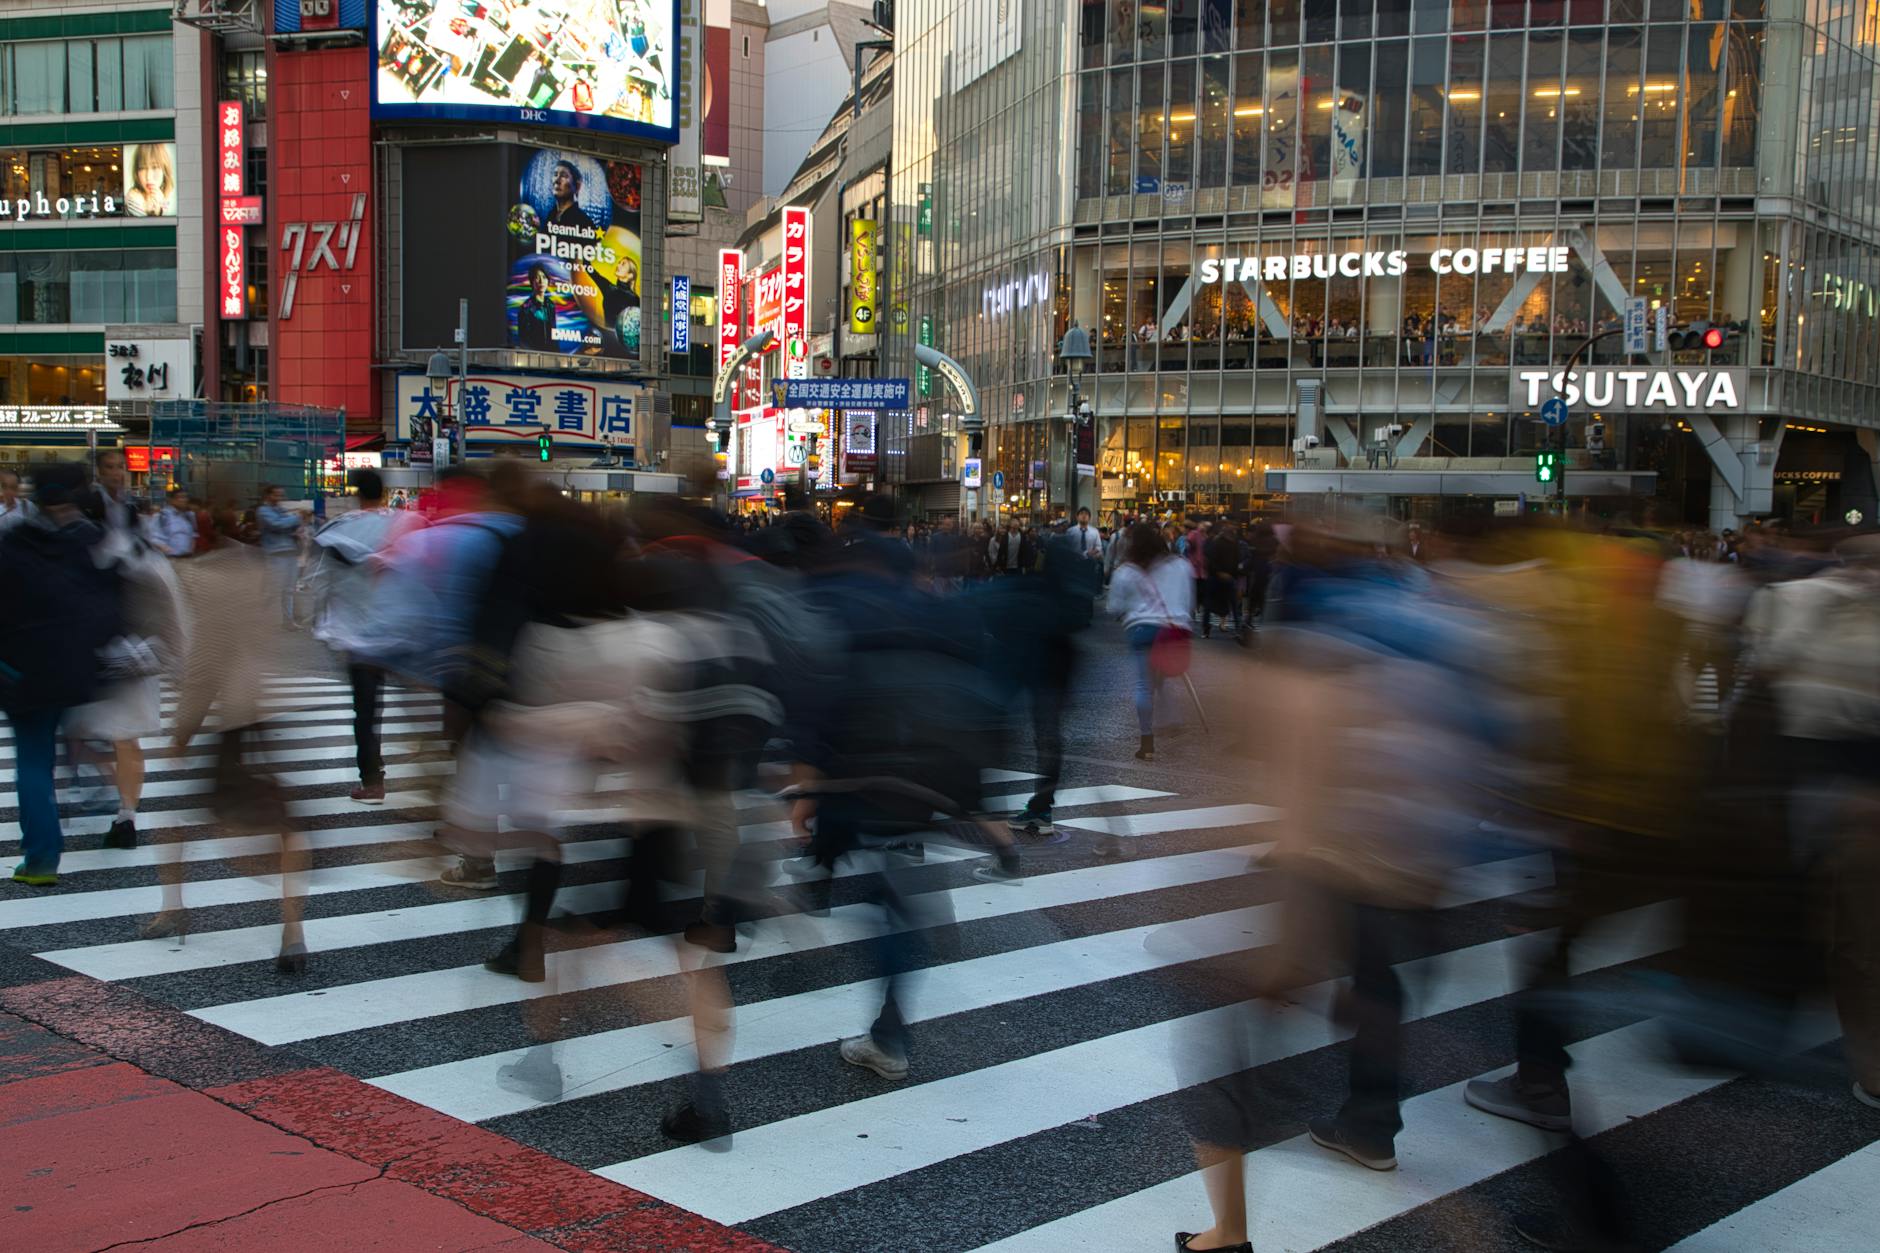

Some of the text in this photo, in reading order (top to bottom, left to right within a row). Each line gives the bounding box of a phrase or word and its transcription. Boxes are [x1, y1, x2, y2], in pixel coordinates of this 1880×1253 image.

[520, 109, 548, 121] DHC
[0, 190, 116, 222] uphoria
[547, 221, 595, 239] teamLab
[278, 193, 367, 320] クスリ
[535, 233, 616, 264] Planets
[559, 262, 594, 273] TOKYO
[786, 221, 805, 313] カラオケ
[1201, 247, 1569, 283] STARBUCKS COFFEE
[555, 282, 597, 297] TOYOSU
[724, 264, 735, 315] BIG ECHO
[675, 279, 686, 350] 大盛堂商事ビル
[856, 308, 871, 321] 4F
[551, 328, 601, 344] DMM.com
[122, 362, 168, 390] 松川
[1520, 371, 1738, 407] TSUTAYA
[788, 383, 906, 399] 全国交通安全運動実施中
[411, 385, 632, 434] 大盛堂書店
[1802, 471, 1840, 480] COFFEE
